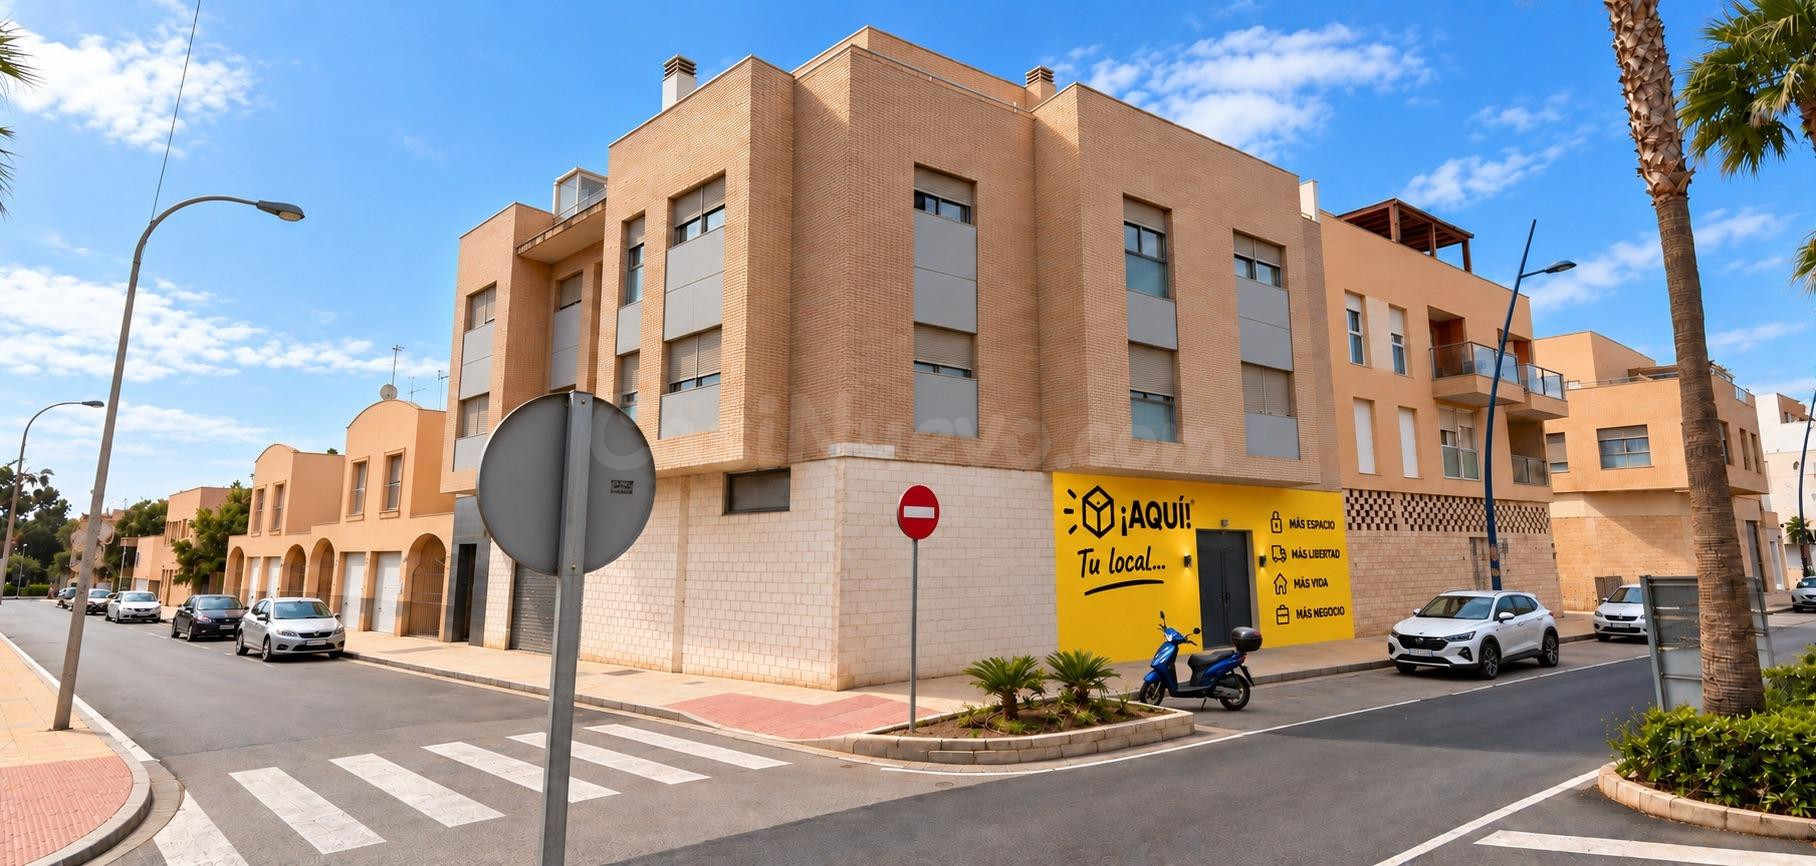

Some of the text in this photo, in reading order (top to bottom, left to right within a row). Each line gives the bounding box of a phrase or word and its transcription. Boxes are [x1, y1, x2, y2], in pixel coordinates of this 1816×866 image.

[1121, 495, 1191, 536] ¡AQUÍ!
[1289, 517, 1335, 530] MÁS ESPACIO
[1291, 547, 1340, 559] MÁS LIBERTAD
[1077, 545, 1166, 578] Tu local...
[1293, 576, 1328, 589] MÁS VIDA
[1296, 606, 1345, 619] MÁS NEGOCIO
